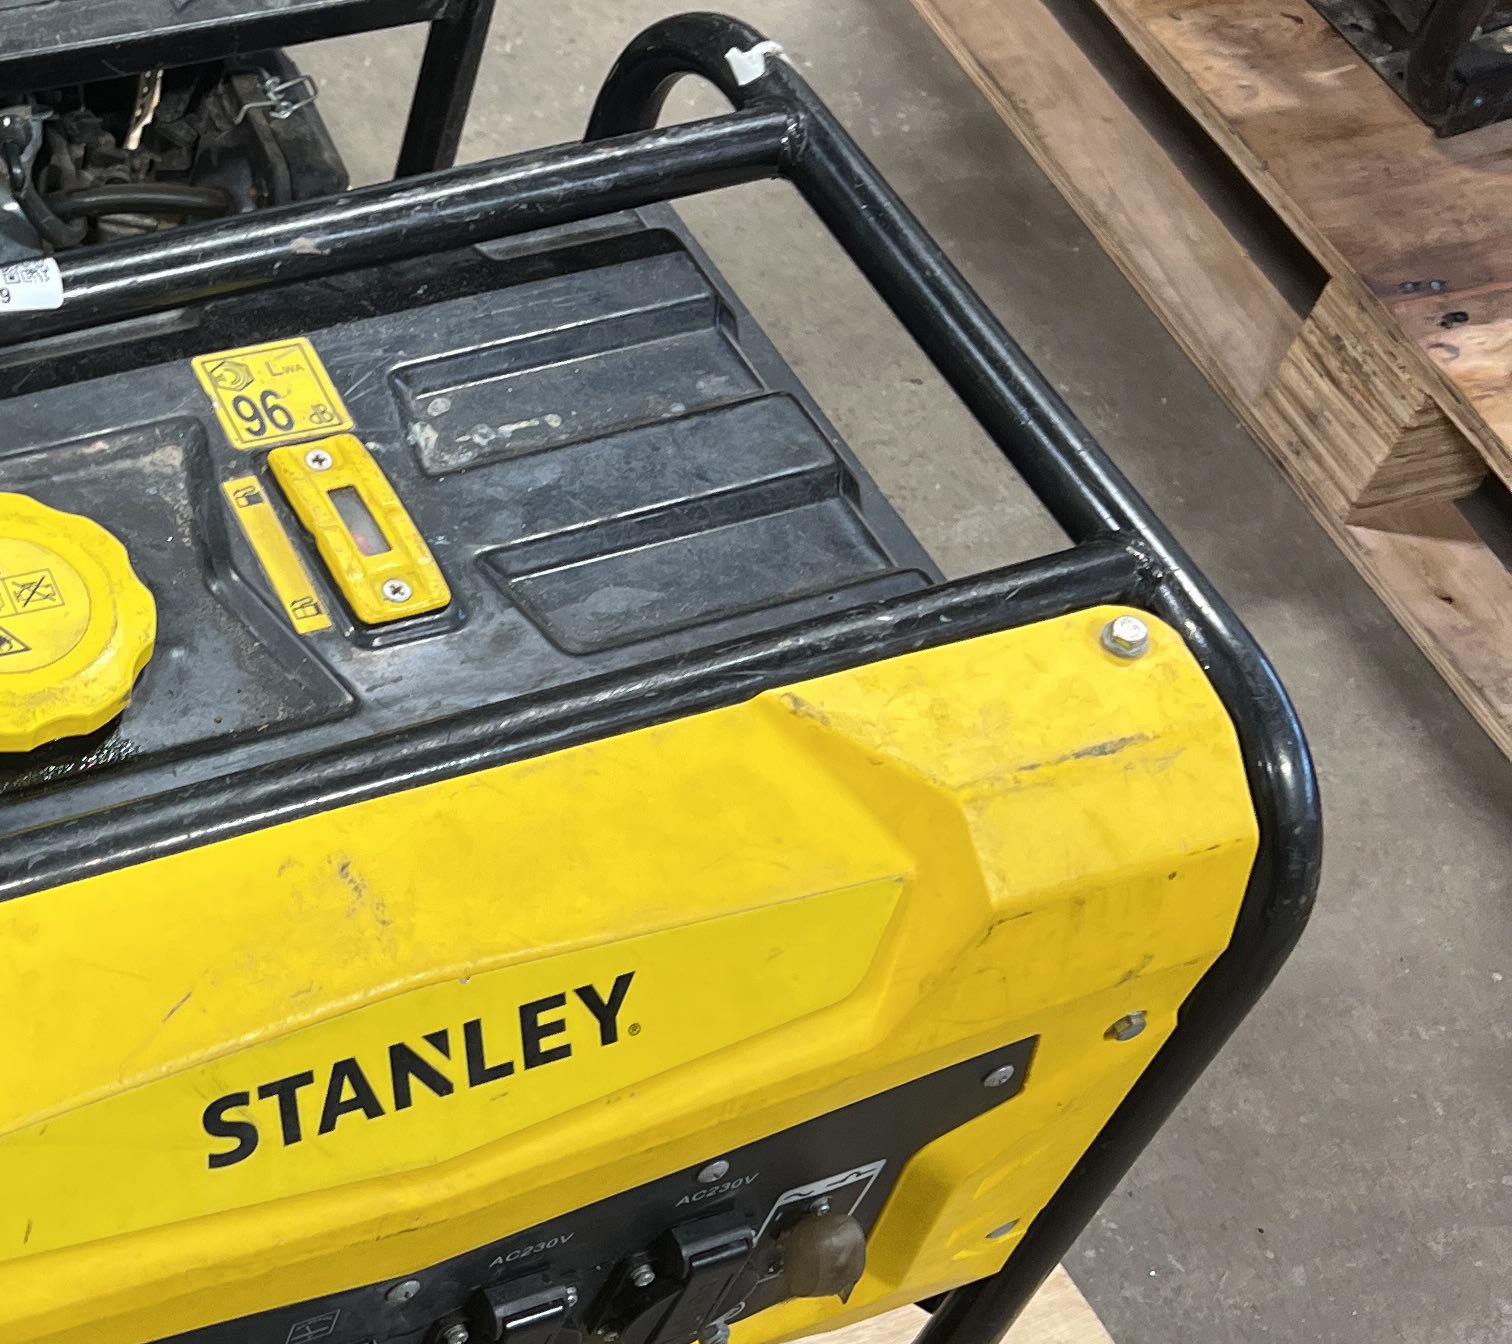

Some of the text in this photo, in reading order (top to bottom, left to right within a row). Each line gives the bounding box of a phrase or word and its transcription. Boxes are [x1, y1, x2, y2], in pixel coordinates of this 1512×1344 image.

[232, 389, 335, 437] 96 dB
[202, 971, 636, 1171] STANLEY
[675, 1171, 760, 1208] AC230V
[489, 1231, 575, 1268] AC230V
